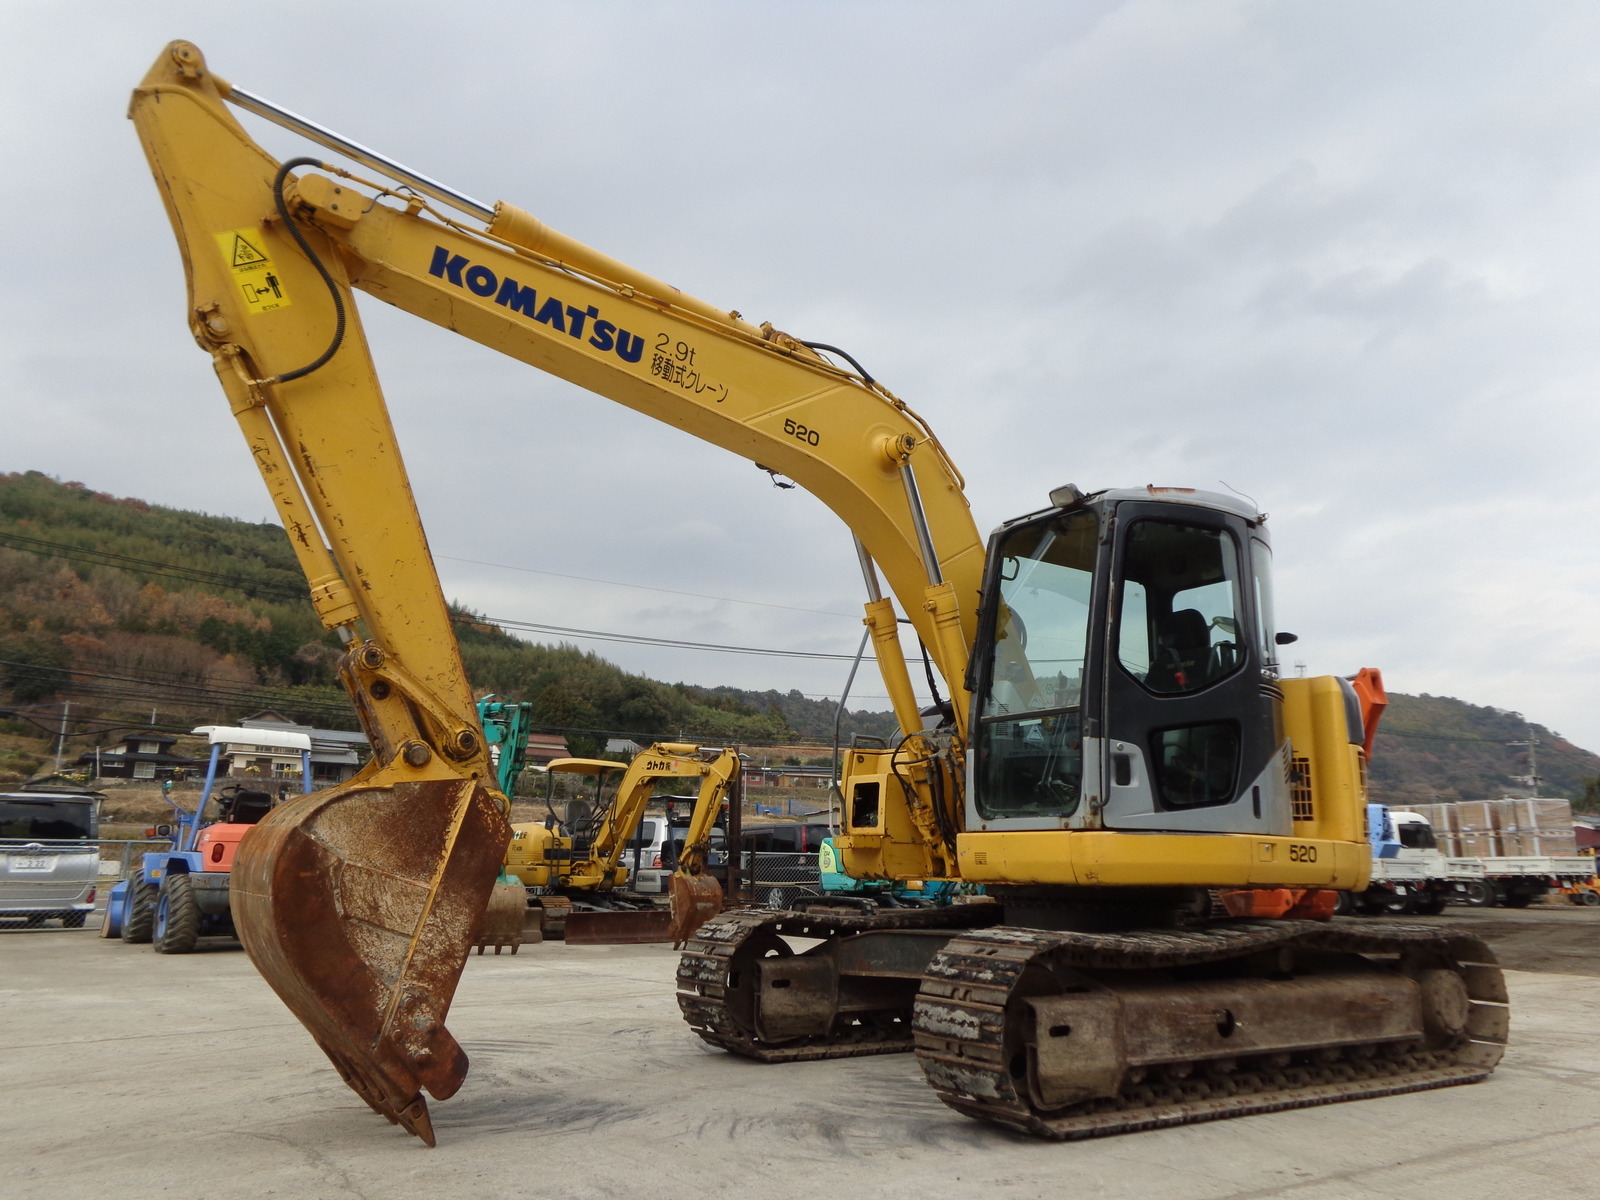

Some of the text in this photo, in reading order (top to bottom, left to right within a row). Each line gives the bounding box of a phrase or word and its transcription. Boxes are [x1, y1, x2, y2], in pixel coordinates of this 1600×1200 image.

[429, 245, 645, 363] KOMATSU
[655, 332, 696, 367] 2.9t
[651, 353, 729, 403] 移動式クレーン
[783, 418, 820, 446] 520
[1290, 845, 1317, 863] 520
